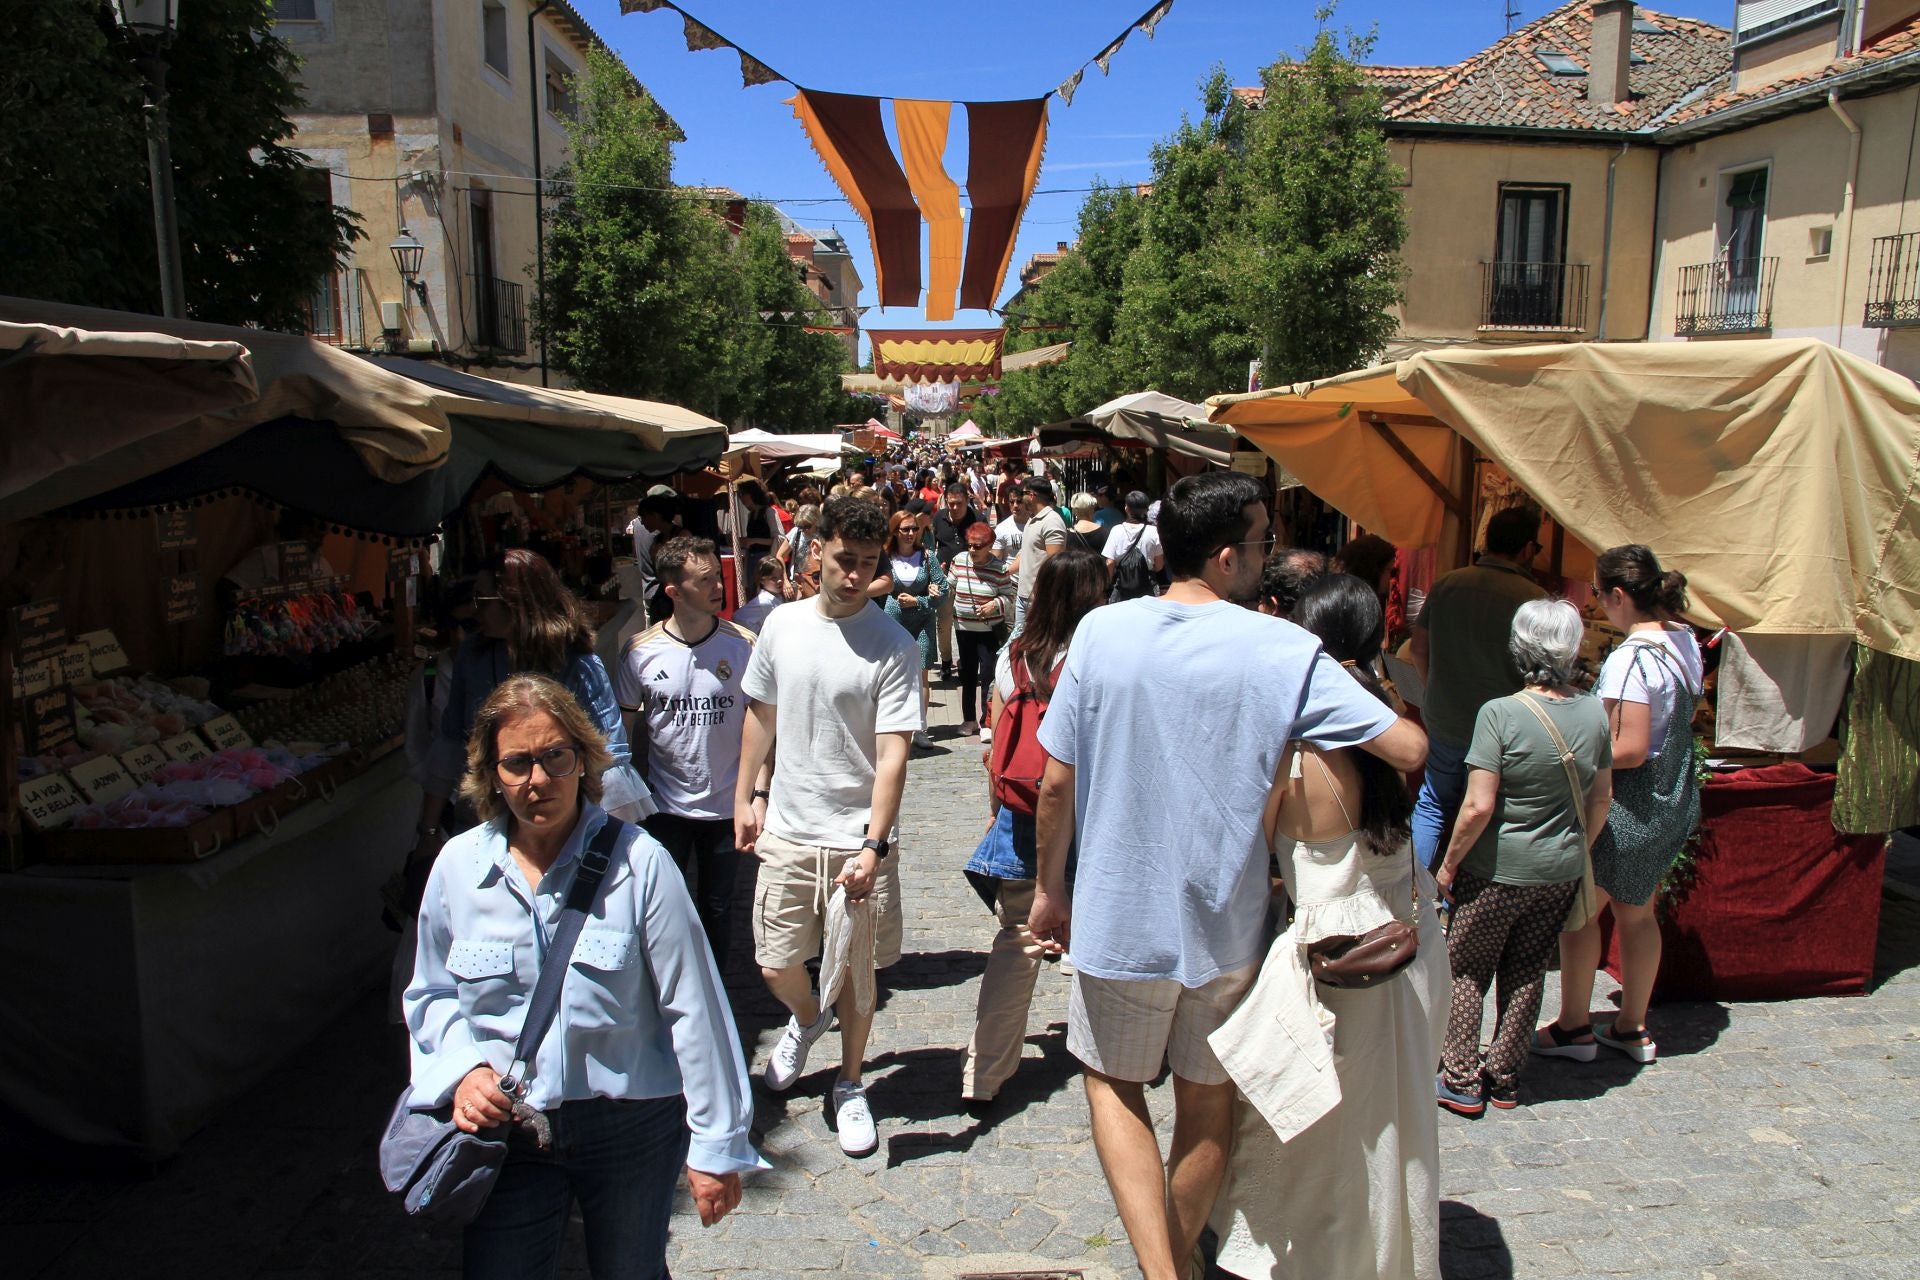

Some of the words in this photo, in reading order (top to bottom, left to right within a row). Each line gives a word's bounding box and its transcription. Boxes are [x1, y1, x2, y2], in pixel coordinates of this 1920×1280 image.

[659, 694, 734, 712] Emirates
[671, 714, 687, 727] FLY
[690, 711, 724, 727] BETTER
[25, 790, 42, 804] LA
[40, 782, 65, 798] VIDA
[32, 806, 48, 819] ES
[47, 794, 80, 813] BELLA
